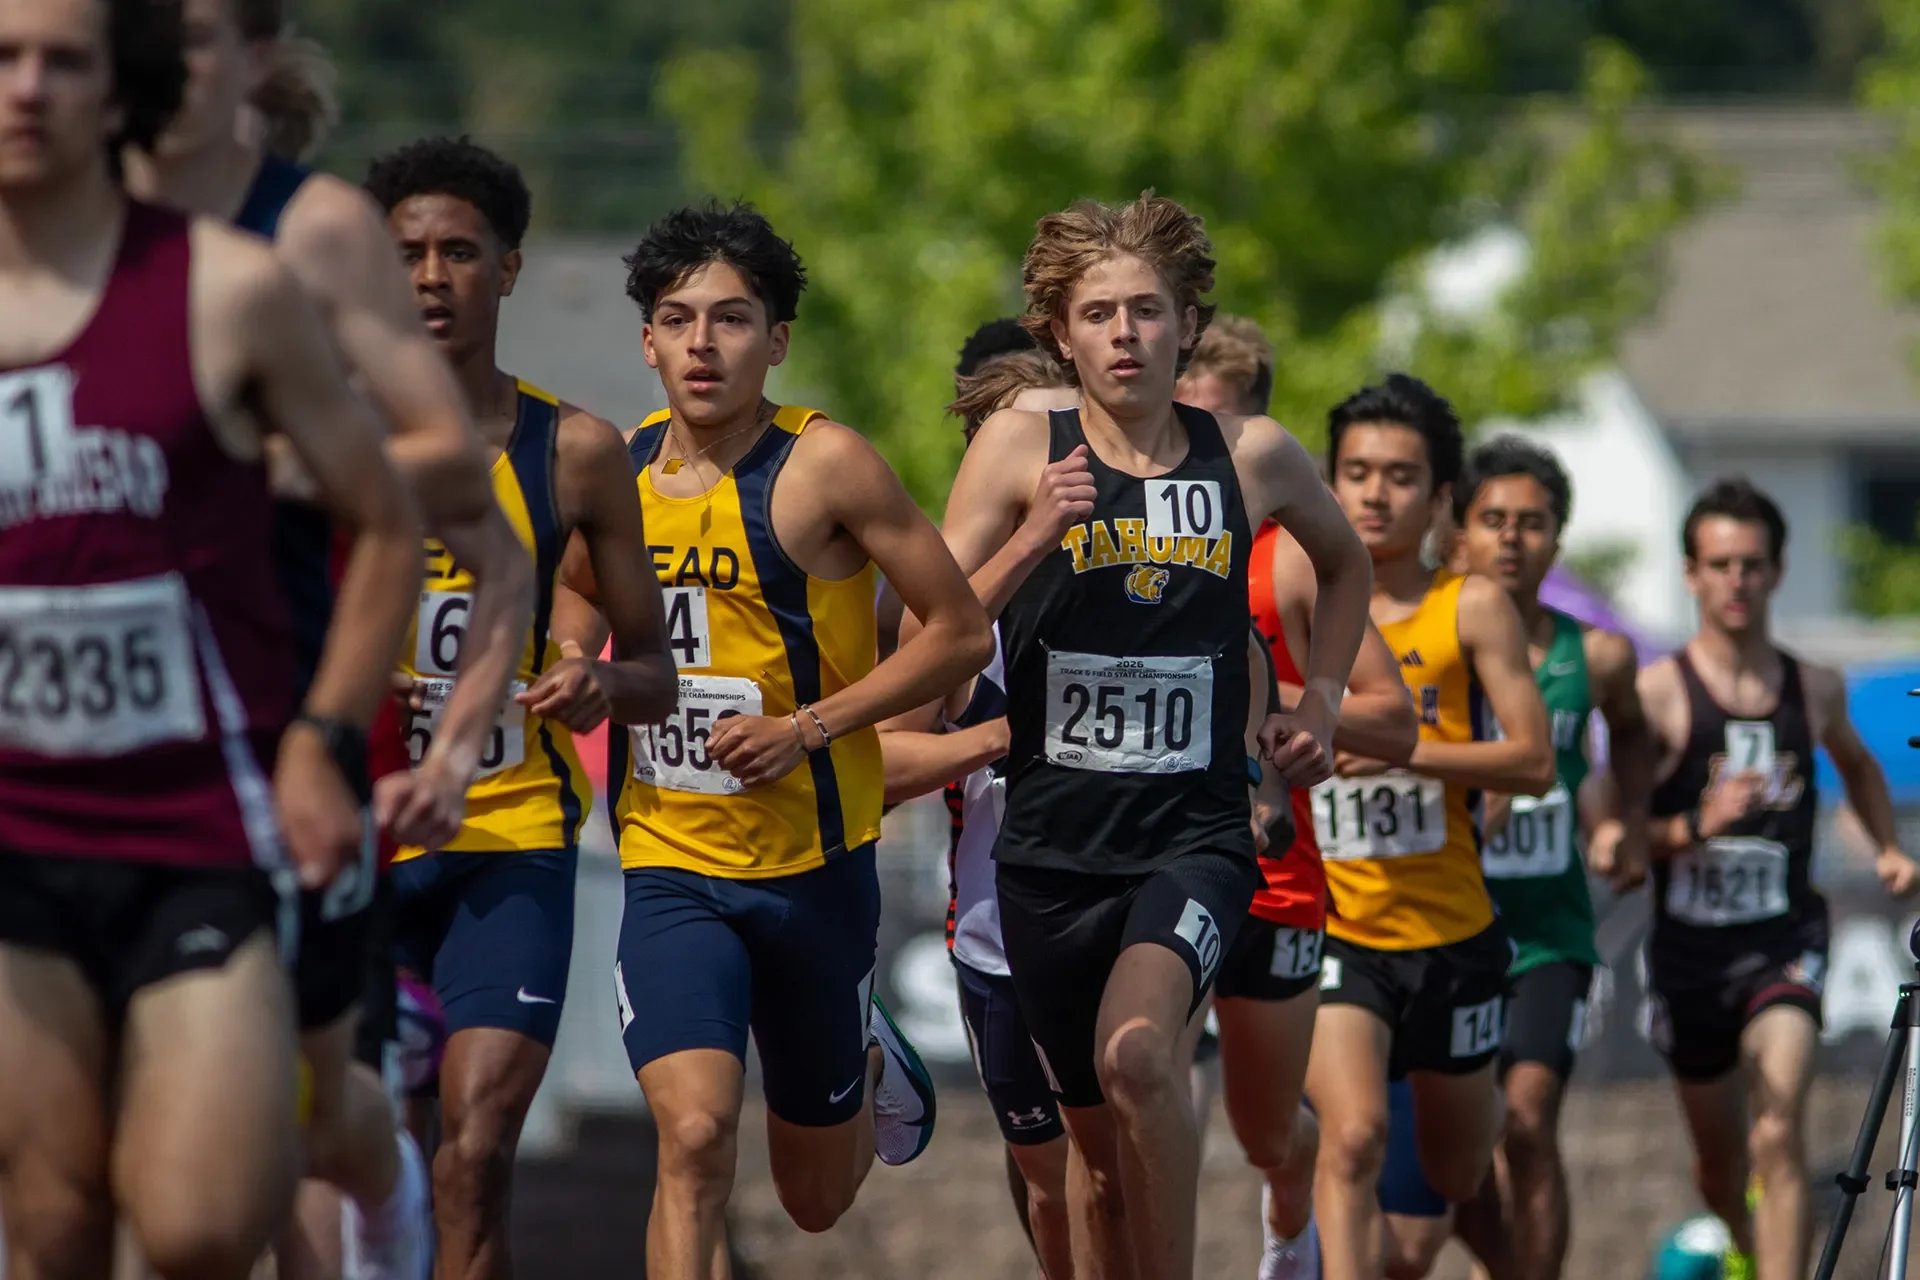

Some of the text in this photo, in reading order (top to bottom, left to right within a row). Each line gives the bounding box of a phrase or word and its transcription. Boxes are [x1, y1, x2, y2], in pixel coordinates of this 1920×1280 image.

[9, 387, 45, 472] 1
[1160, 483, 1212, 535] 10
[1061, 518, 1233, 580] TAHOMA
[430, 597, 469, 672] 6
[665, 591, 700, 664] 4
[0, 626, 165, 723] 2335
[677, 679, 693, 687] 26
[1060, 667, 1083, 676] TRACK
[1092, 670, 1113, 678] FIELD
[1114, 671, 1136, 679] STATE
[1138, 672, 1197, 680] CHAMPIONSHIPS
[1116, 660, 1144, 668] 2026
[688, 692, 746, 701] CHAMPIONSHIPS
[1061, 683, 1193, 751] 2510
[647, 706, 742, 771] 155
[1740, 731, 1760, 766] 7
[1321, 783, 1425, 839] 1131
[1197, 914, 1220, 973] 10
[1464, 1004, 1494, 1051] 14
